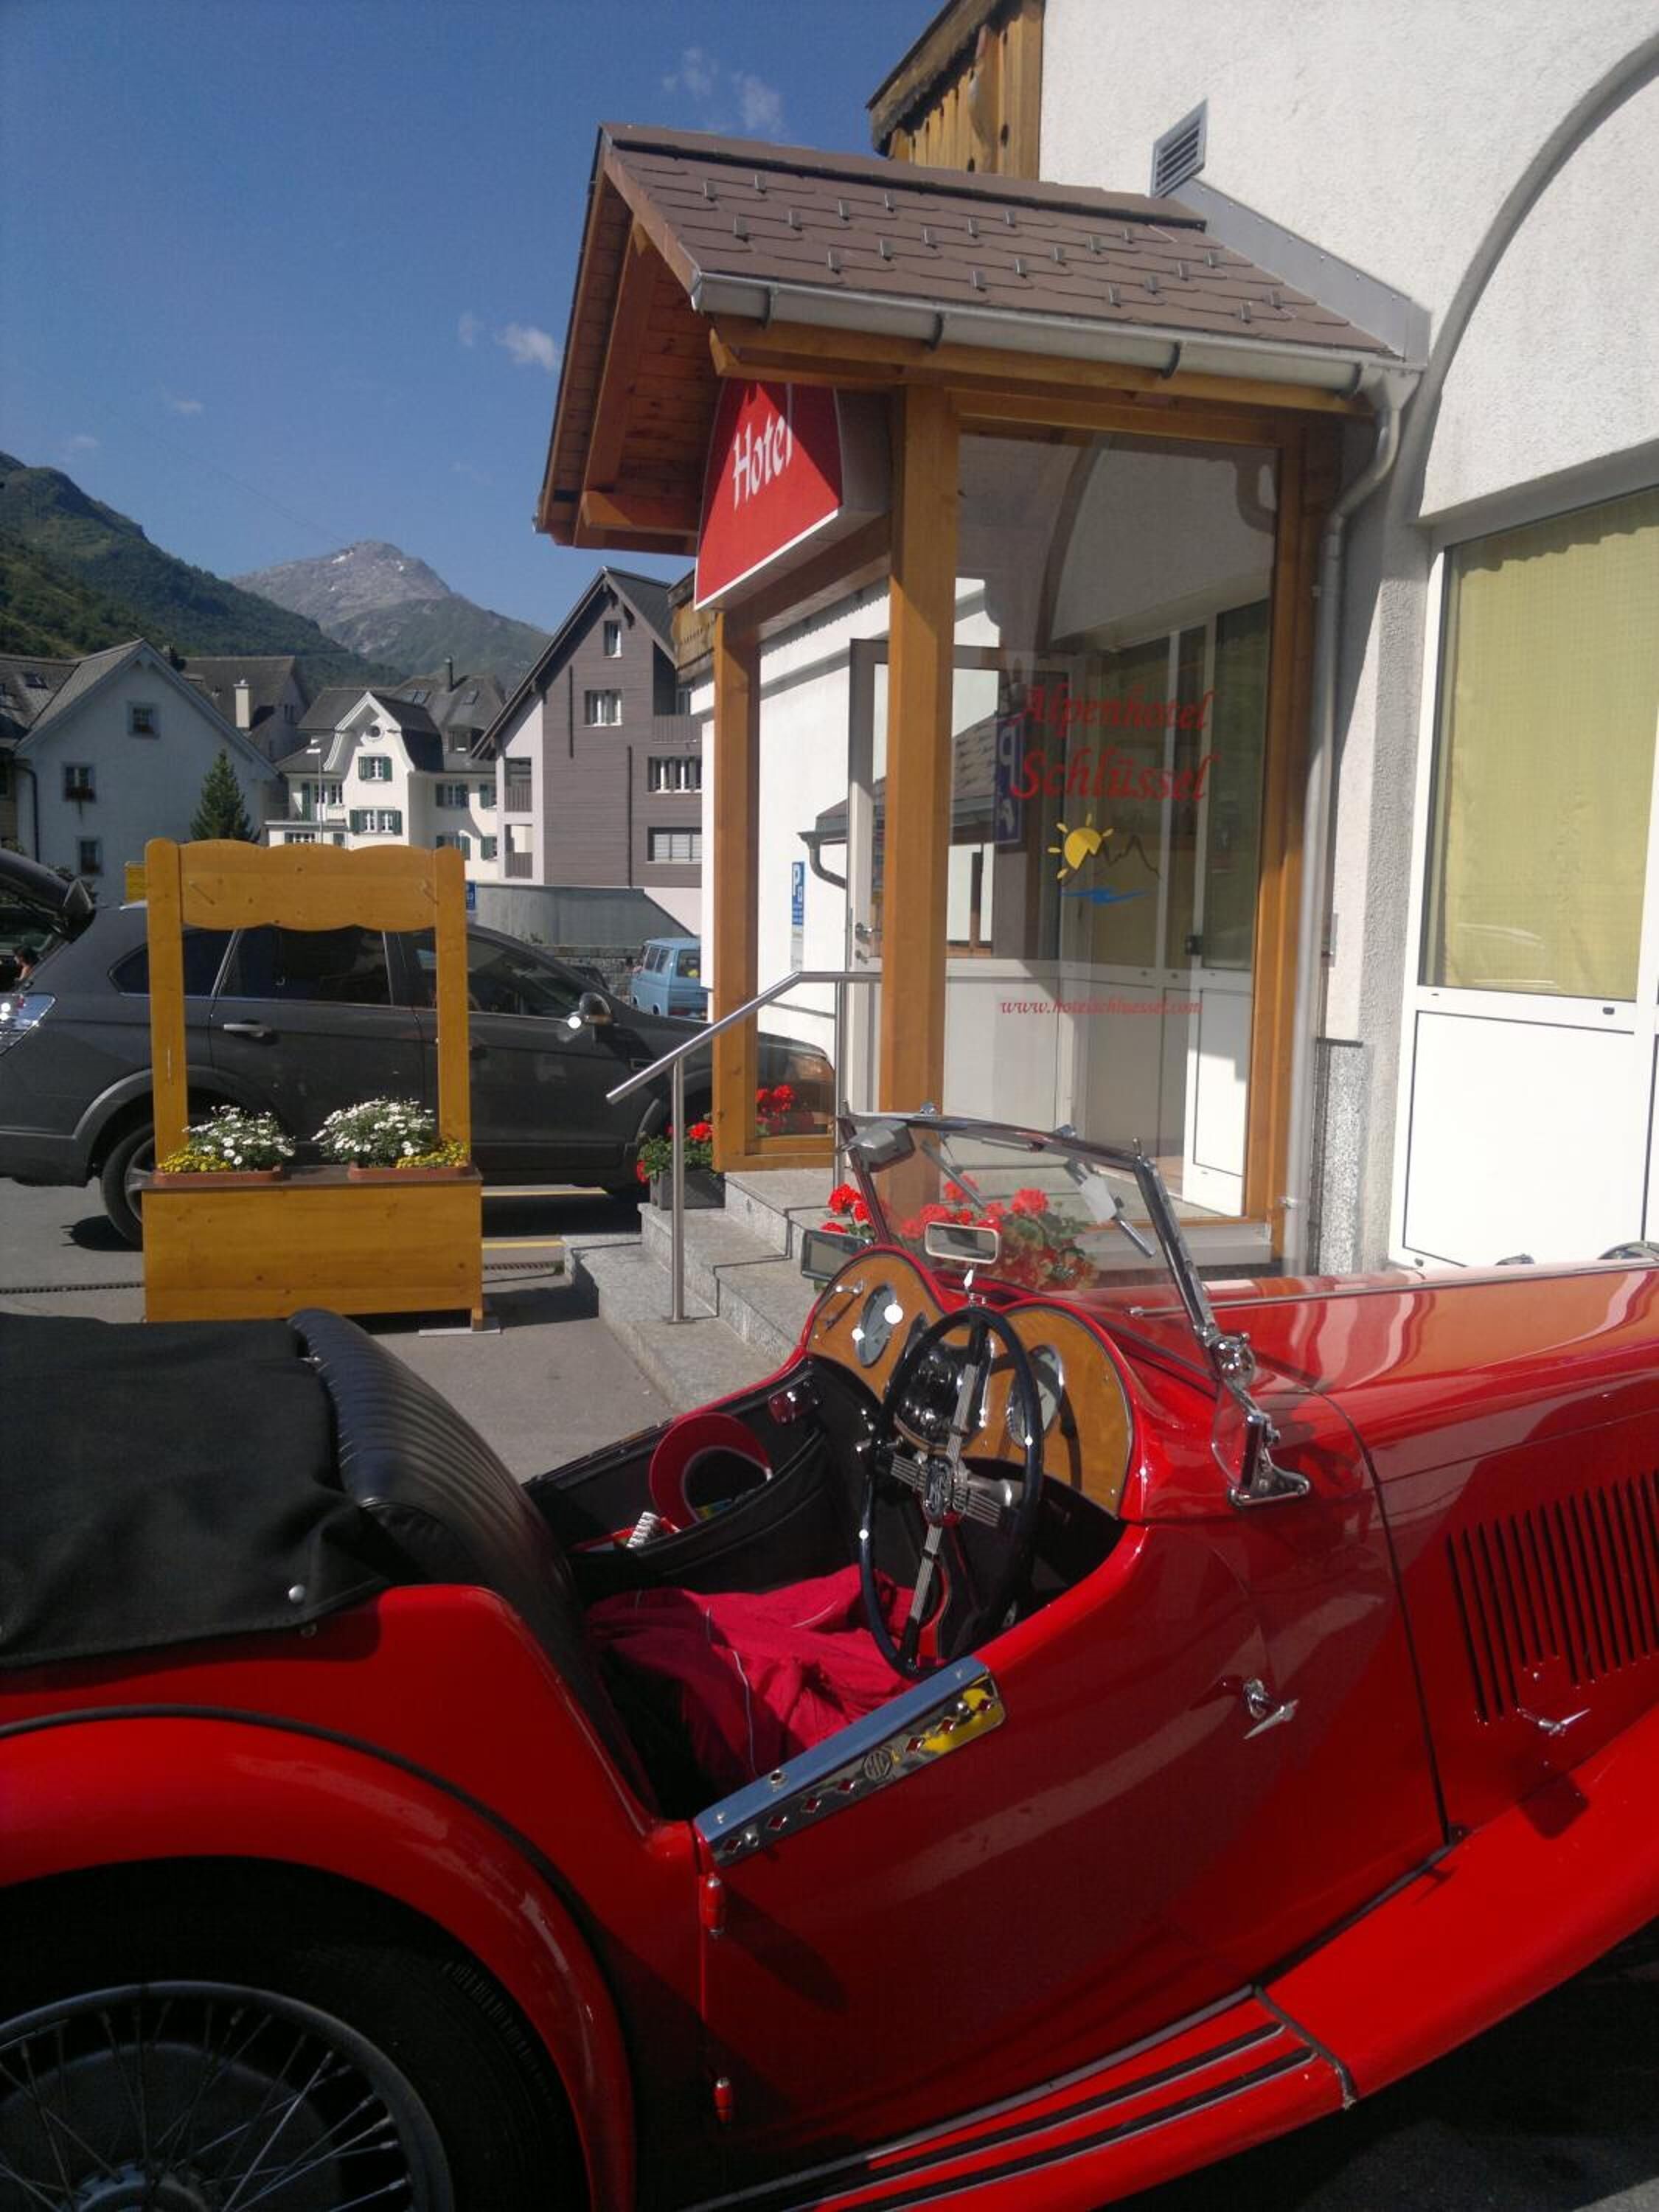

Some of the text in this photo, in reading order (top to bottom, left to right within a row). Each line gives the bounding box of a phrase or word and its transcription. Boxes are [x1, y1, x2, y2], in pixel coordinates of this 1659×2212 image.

[733, 412, 793, 512] Hotel
[1009, 684, 1216, 736] Alpenhotel
[1010, 748, 1220, 802] Schlüssel
